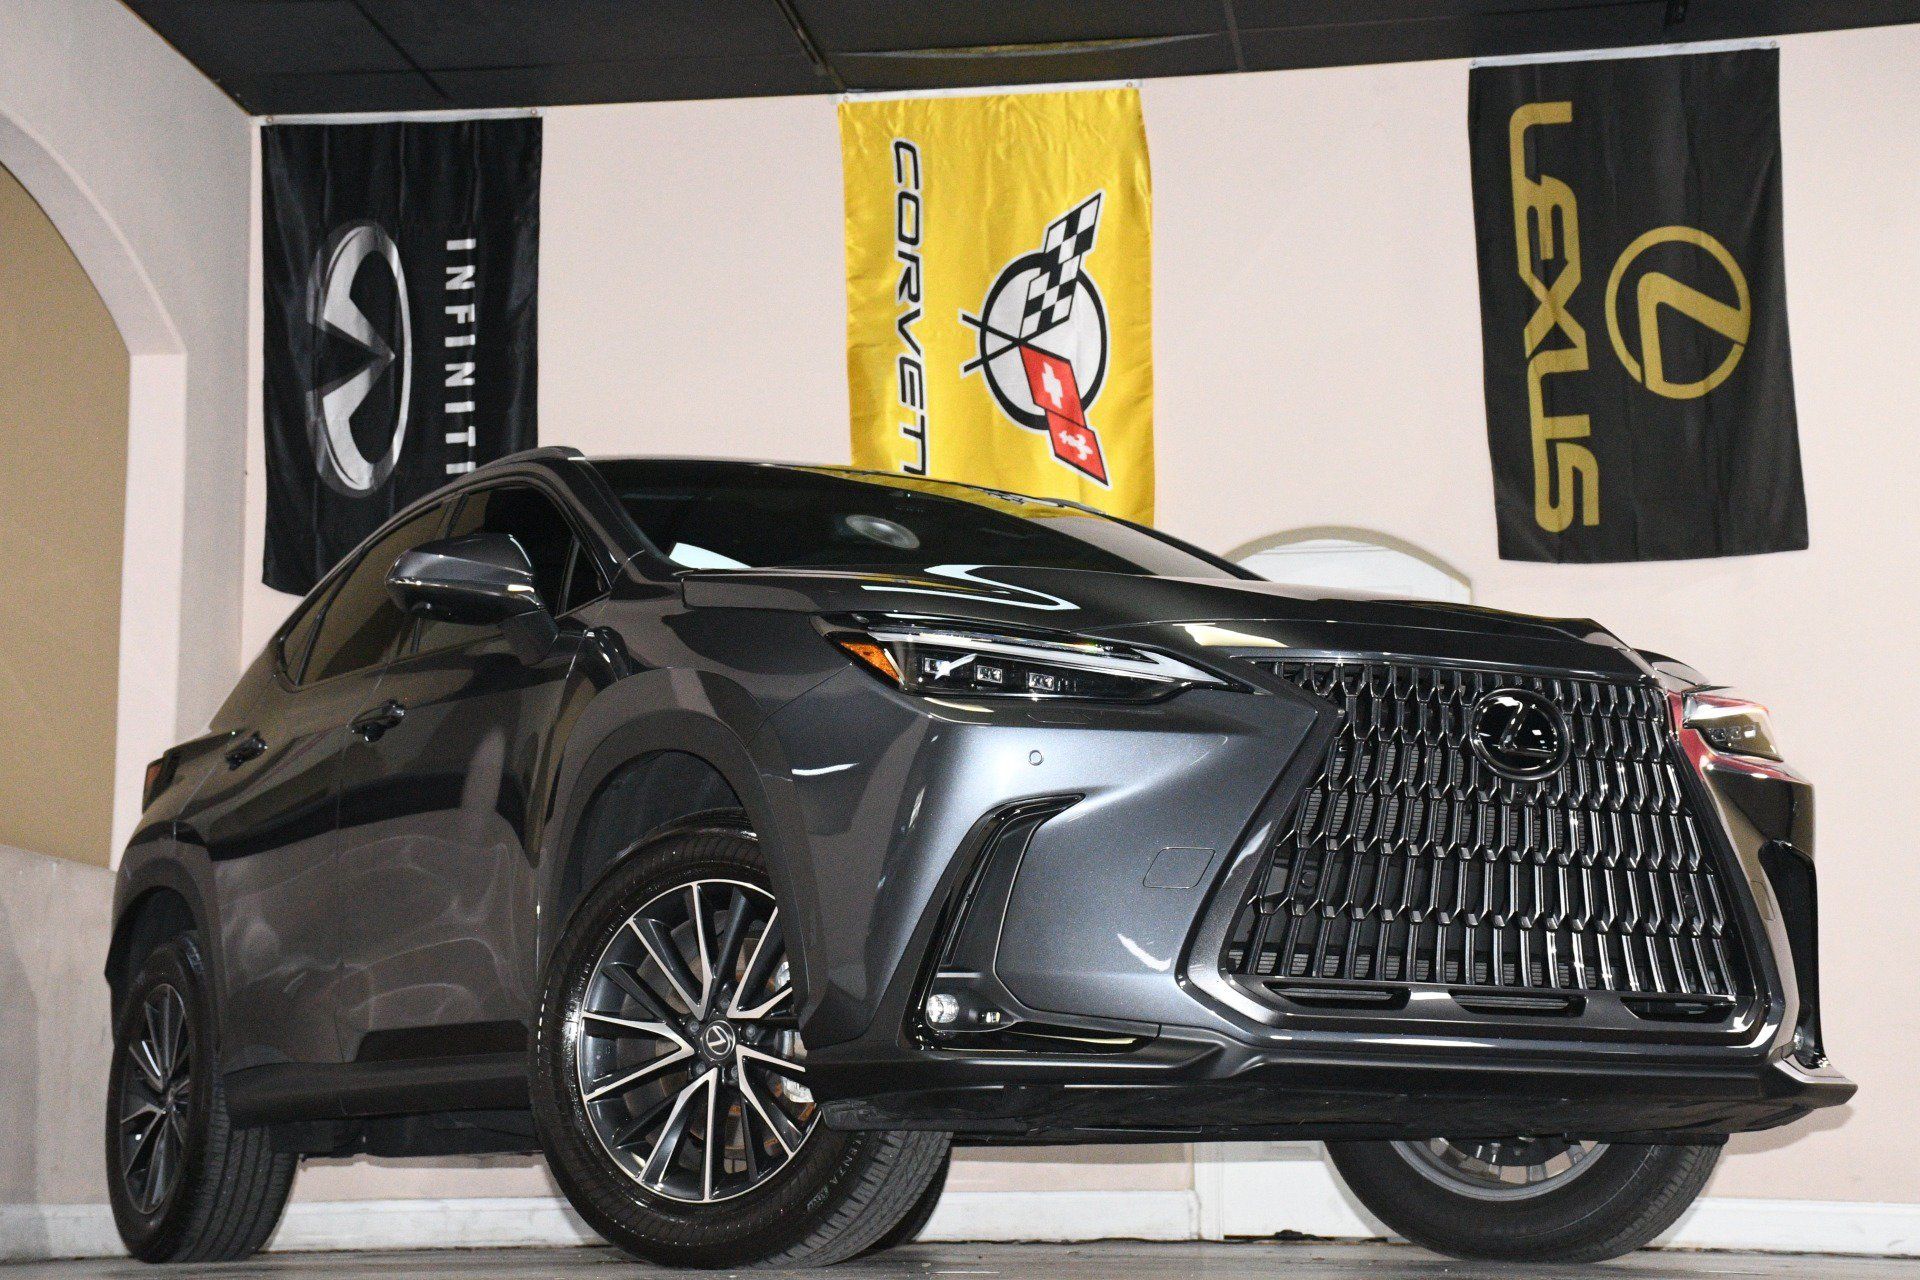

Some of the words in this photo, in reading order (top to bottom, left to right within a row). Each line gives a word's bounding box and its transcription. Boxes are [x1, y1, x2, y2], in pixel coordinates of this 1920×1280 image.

[445, 238, 477, 475] INFINITI
[892, 139, 928, 476] CORVETT
[1508, 100, 1600, 533] LEXUS
